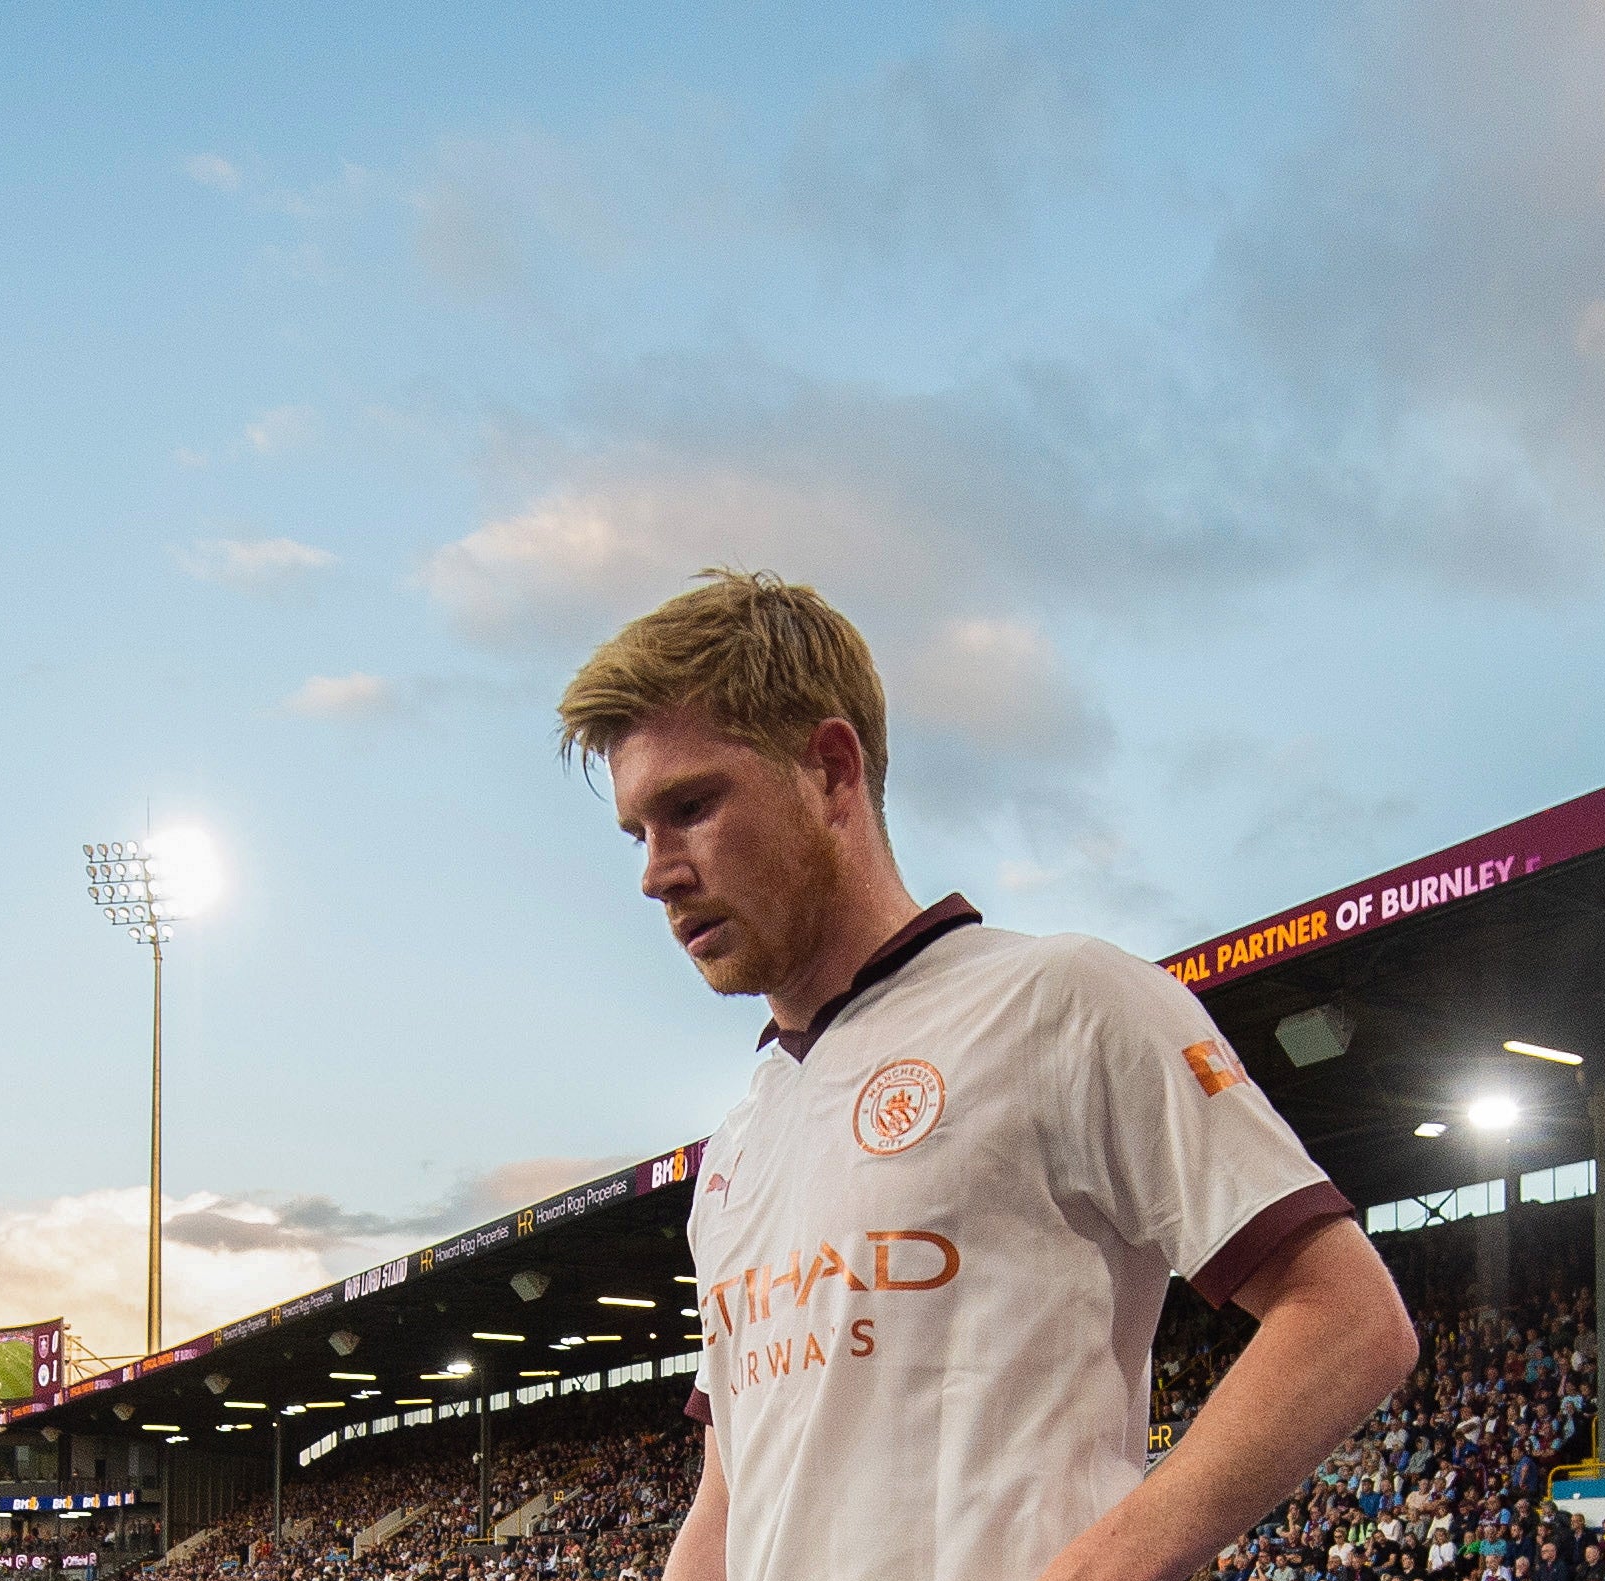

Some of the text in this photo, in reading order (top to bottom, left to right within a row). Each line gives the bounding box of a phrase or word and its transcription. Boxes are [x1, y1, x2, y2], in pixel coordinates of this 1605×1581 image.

[1217, 910, 1328, 972] PARTNER
[1335, 894, 1373, 931] OF
[1382, 855, 1515, 919] BURNLEY
[878, 1137, 905, 1147] CITY
[651, 1148, 687, 1188] BK8
[517, 1179, 627, 1237] HR Howard Rigg Properties
[420, 1249, 433, 1273] HR
[435, 1243, 459, 1262] Howard
[477, 1225, 509, 1247] Properties
[730, 1319, 874, 1395] IRWAS
[1148, 1424, 1172, 1450] HR
